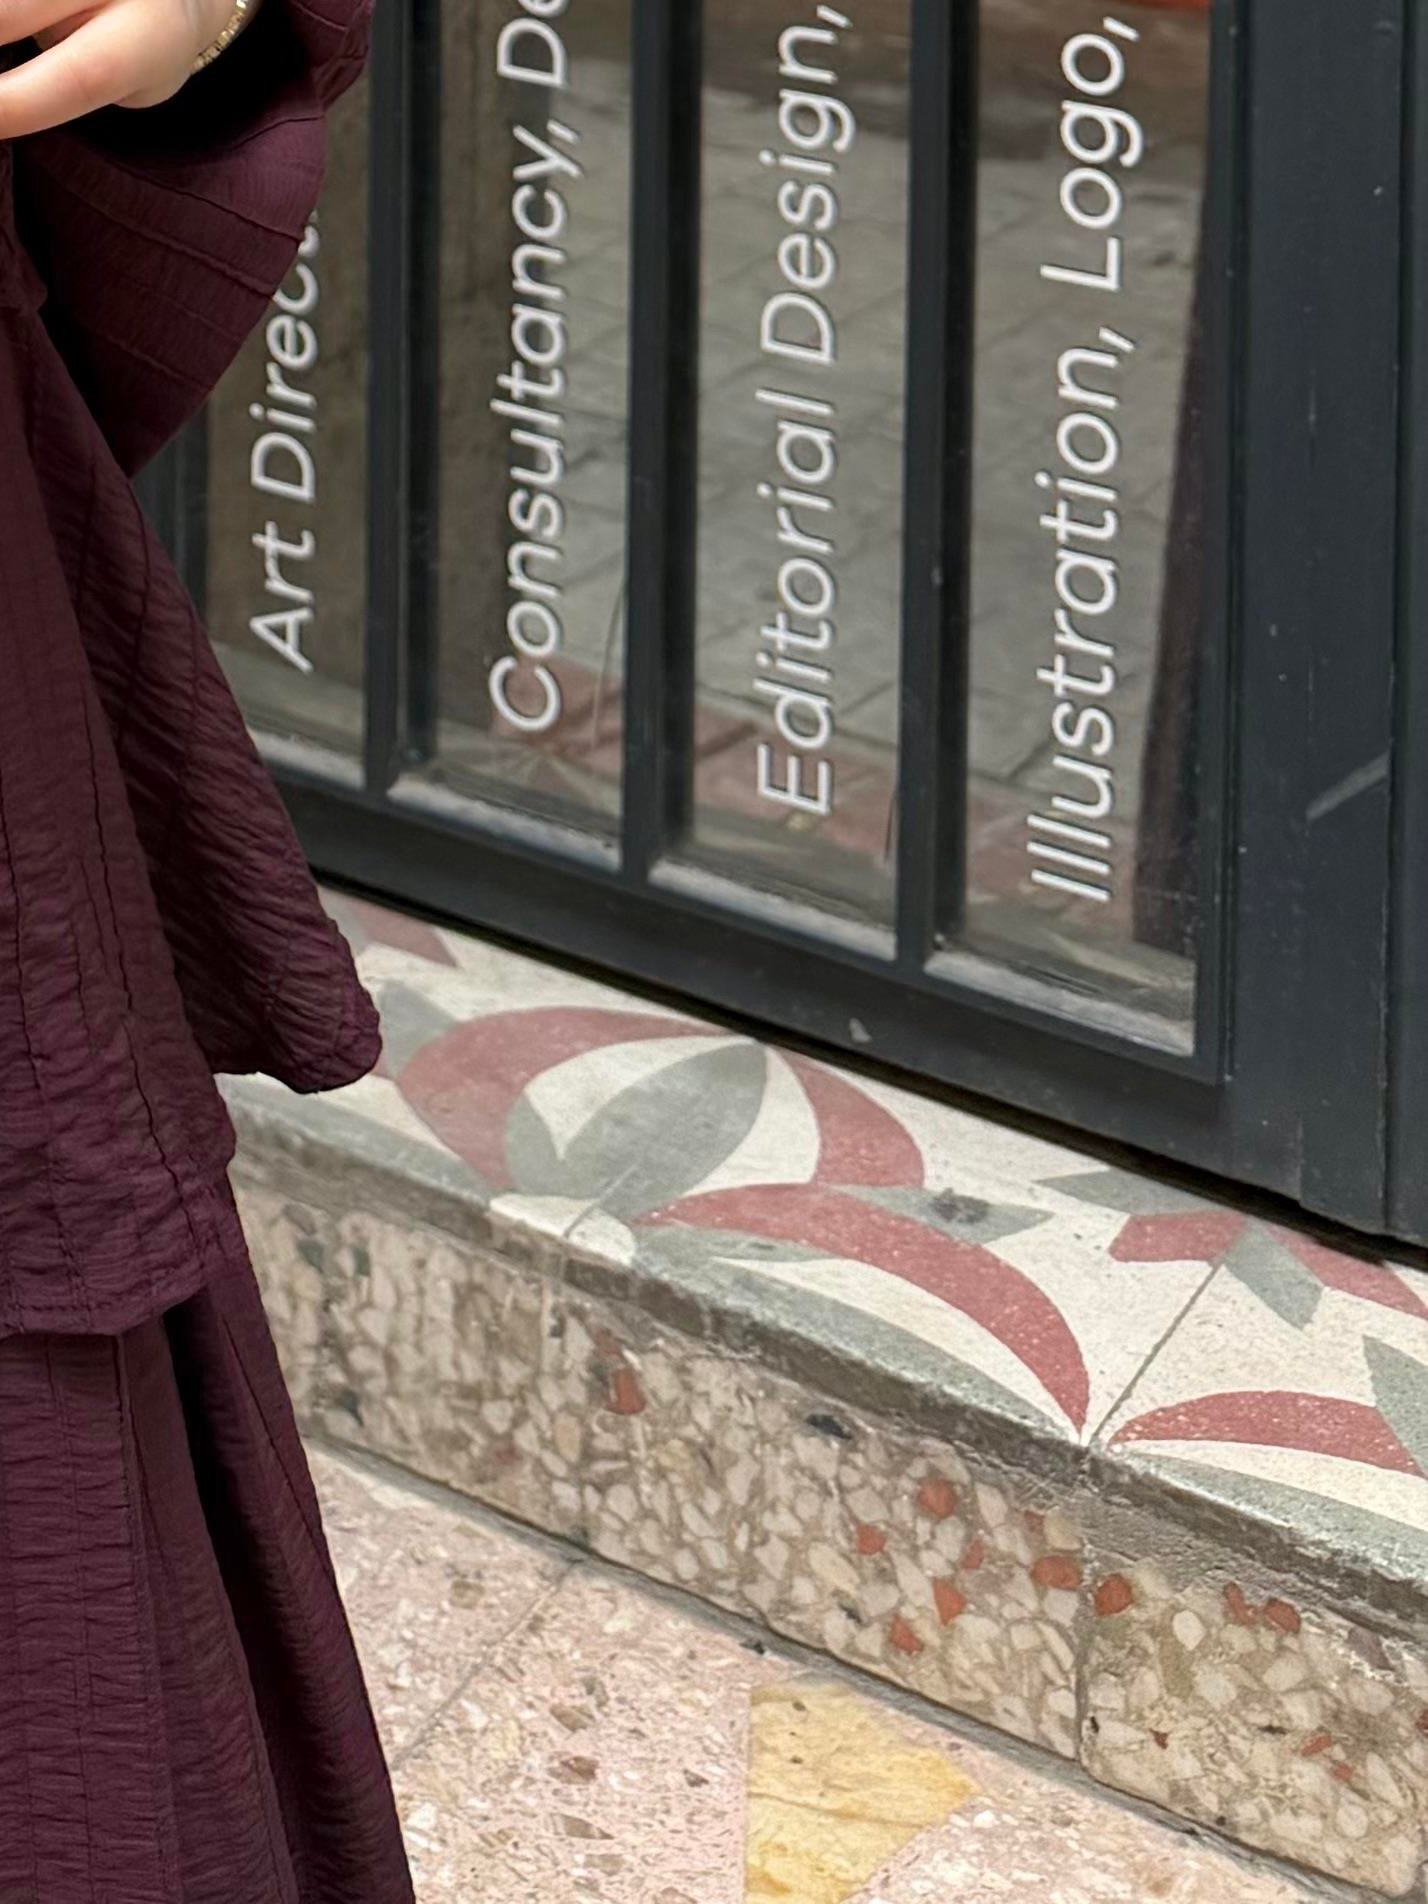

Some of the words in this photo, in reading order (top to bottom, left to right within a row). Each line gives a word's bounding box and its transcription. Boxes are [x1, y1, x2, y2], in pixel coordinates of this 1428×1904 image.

[758, 5, 856, 366] Design,
[1040, 16, 1144, 292] Logo,
[249, 208, 320, 503] Direc
[490, 119, 583, 731] Consultancy,
[250, 520, 316, 674] Art
[755, 387, 834, 815] Editorial
[1027, 326, 1135, 902] Illustration,
